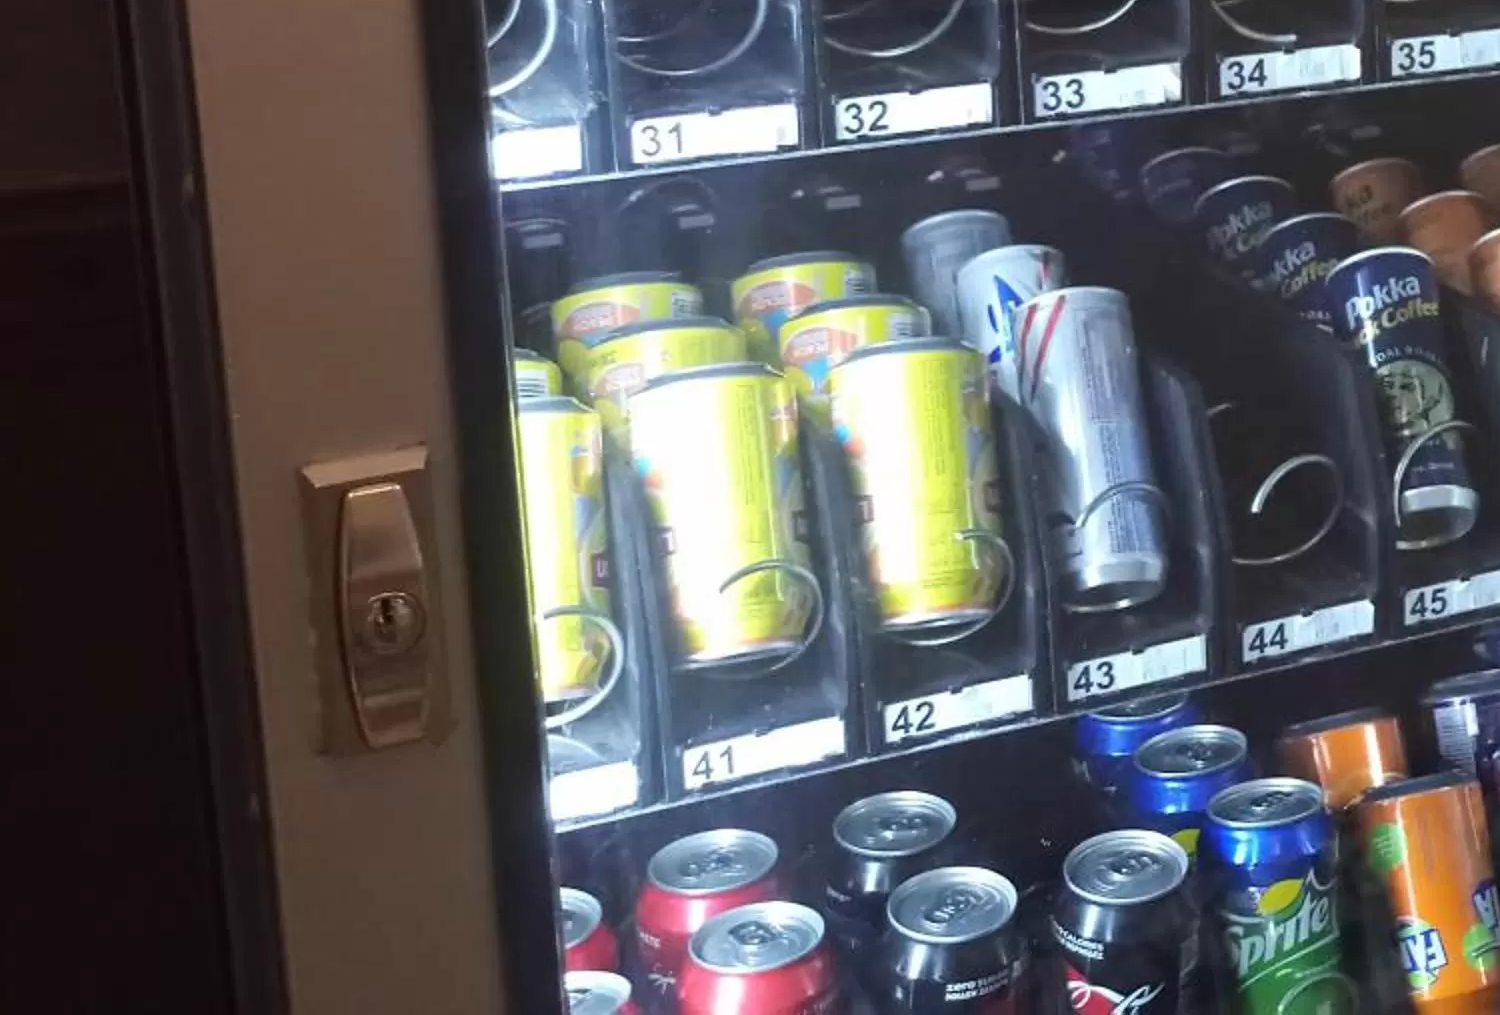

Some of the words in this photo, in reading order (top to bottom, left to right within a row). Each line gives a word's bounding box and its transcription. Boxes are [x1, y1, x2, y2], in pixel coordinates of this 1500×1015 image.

[1397, 39, 1436, 72] 35
[1226, 57, 1268, 90] 34
[1042, 78, 1084, 111] 33
[843, 101, 888, 134] 32
[641, 123, 685, 156] 31
[1345, 274, 1421, 330] Pokka
[1409, 585, 1449, 619] 45
[1249, 621, 1289, 656] 44
[1073, 660, 1116, 694] 43
[892, 700, 936, 736] 42
[692, 745, 735, 781] 41
